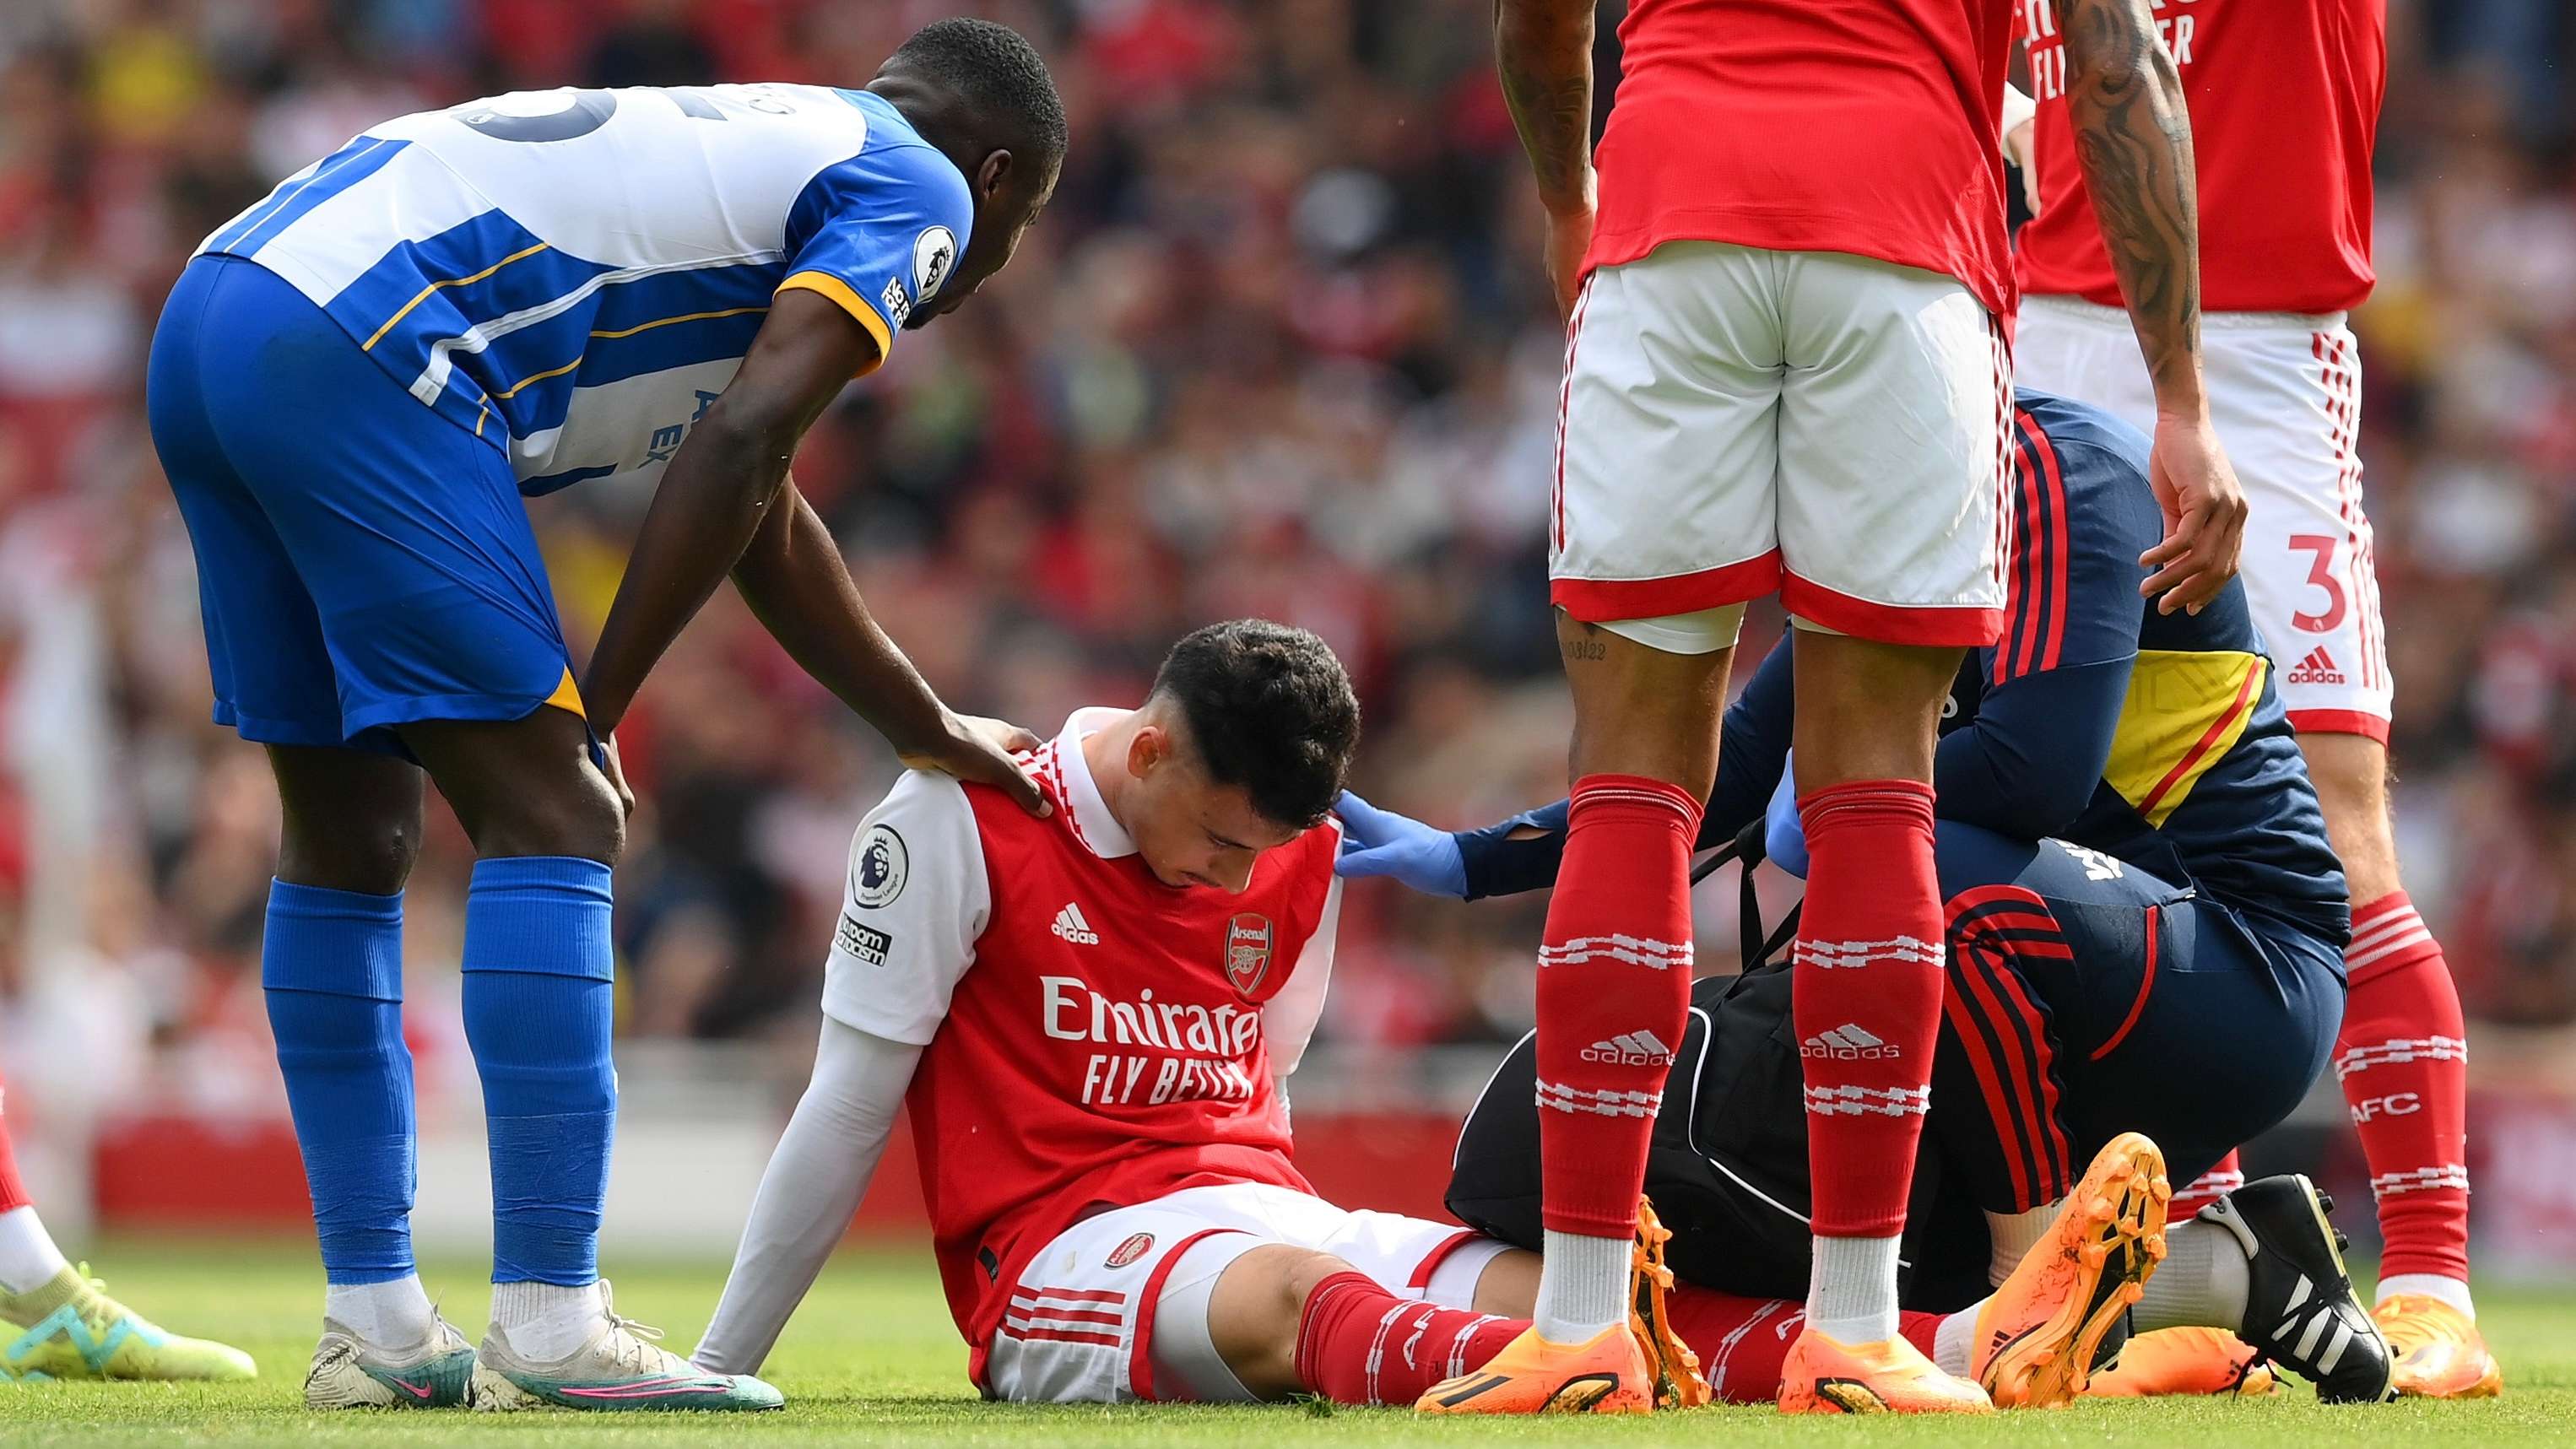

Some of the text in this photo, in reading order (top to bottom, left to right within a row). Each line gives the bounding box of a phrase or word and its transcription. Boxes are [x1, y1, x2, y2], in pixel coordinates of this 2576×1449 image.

[2288, 535, 2346, 633] 3
[2288, 668, 2345, 684] adidas
[1051, 923, 1099, 945] adidas
[1231, 926, 1266, 941] Arsenal
[1039, 976, 1259, 1057] Emirate
[1799, 1045, 1900, 1060] adidas
[1081, 1055, 1148, 1105] FLY
[2350, 1092, 2422, 1127] AFC
